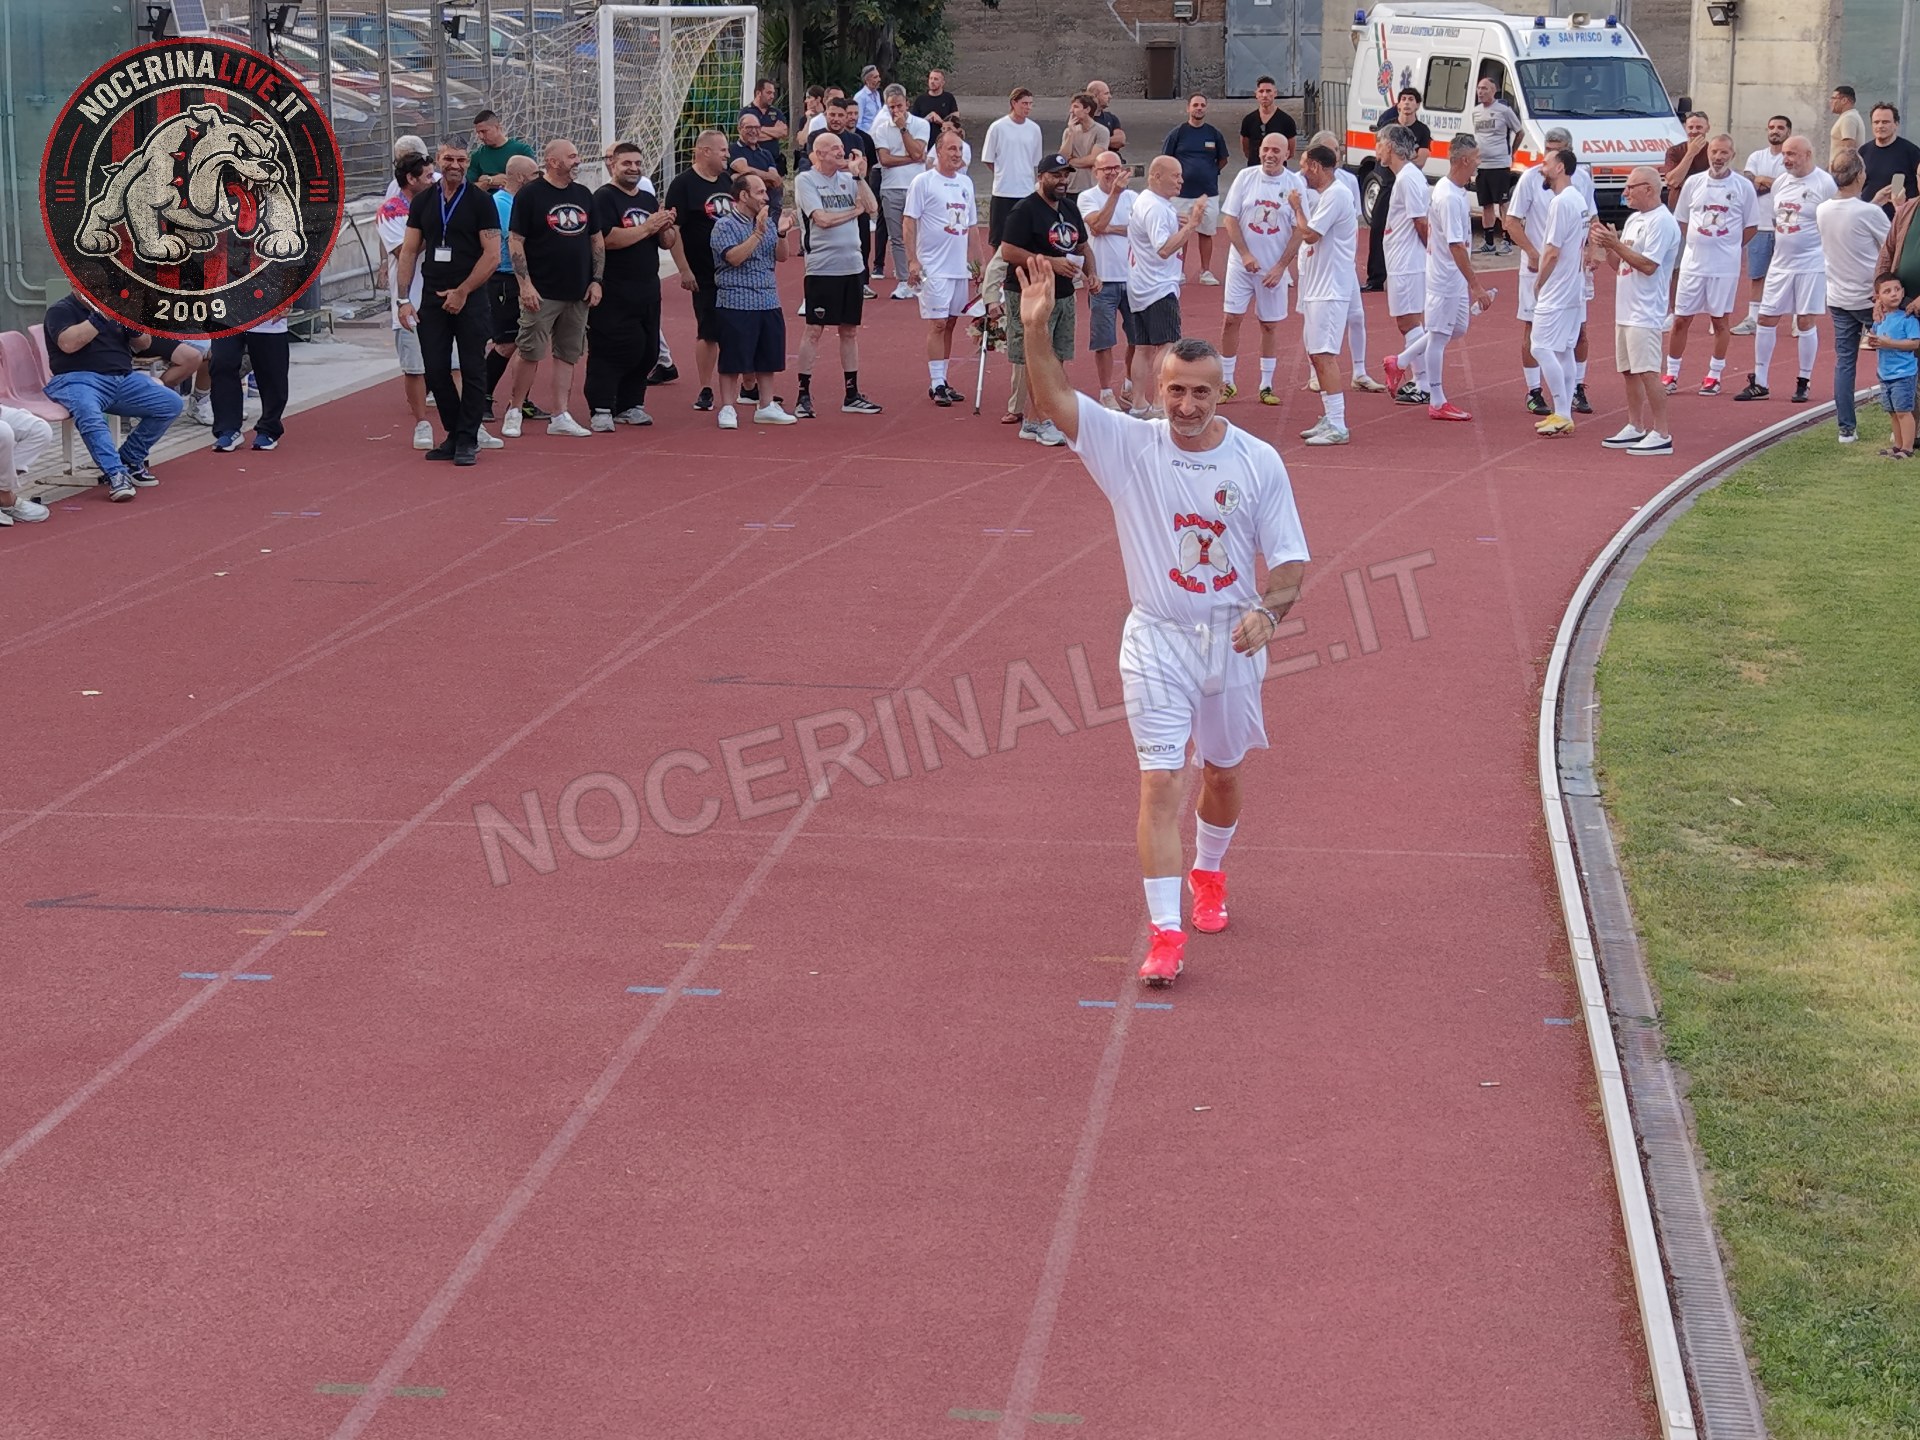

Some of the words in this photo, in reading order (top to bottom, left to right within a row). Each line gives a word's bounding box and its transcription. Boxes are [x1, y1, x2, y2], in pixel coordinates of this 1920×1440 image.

[1558, 32, 1574, 43] SAN
[1575, 32, 1602, 43] PRISCO
[1172, 459, 1217, 471] GIVOVA
[1137, 744, 1176, 753] GIVOVA
